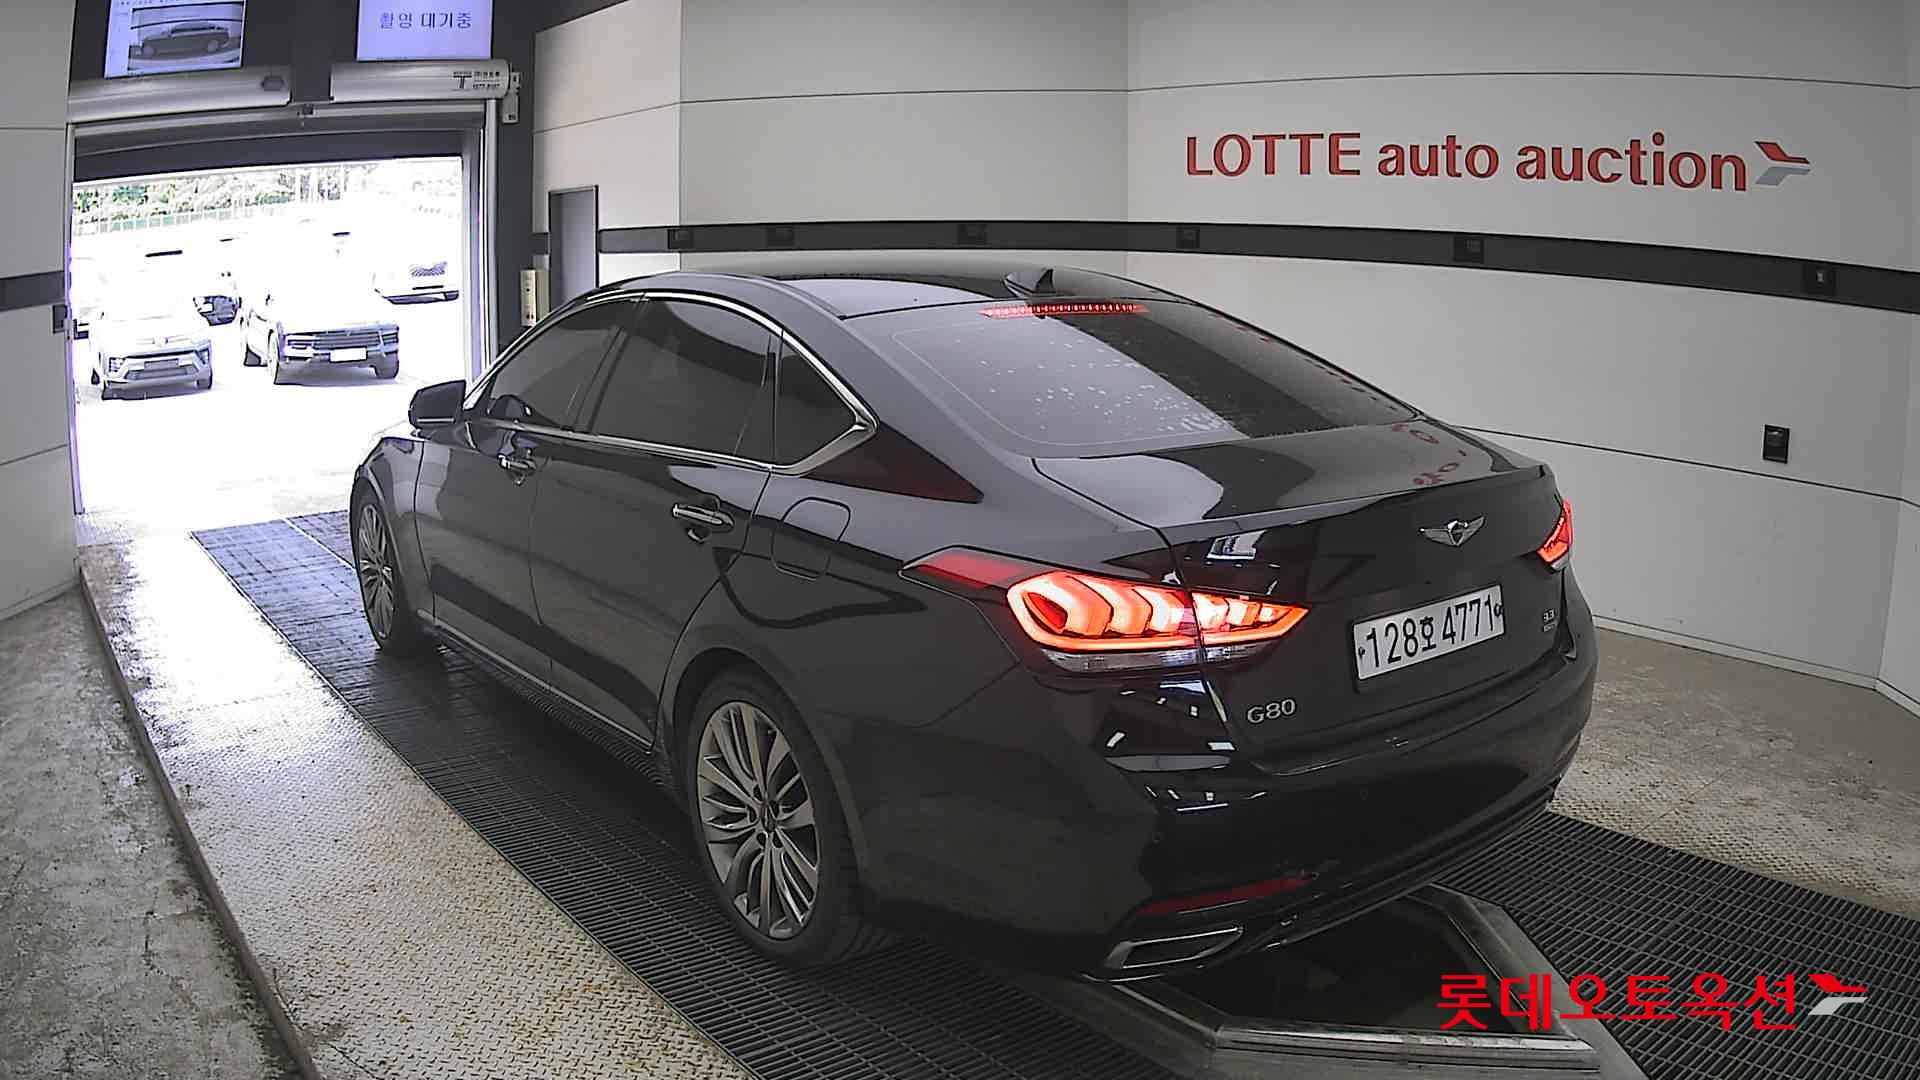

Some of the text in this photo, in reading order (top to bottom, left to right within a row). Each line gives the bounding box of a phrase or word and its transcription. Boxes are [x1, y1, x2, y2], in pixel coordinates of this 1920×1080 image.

[421, 12, 472, 29] 대기중
[1187, 132, 1747, 192] LOTTE auto auction
[1366, 594, 1495, 668] 128호 4771
[1247, 699, 1296, 723] G80
